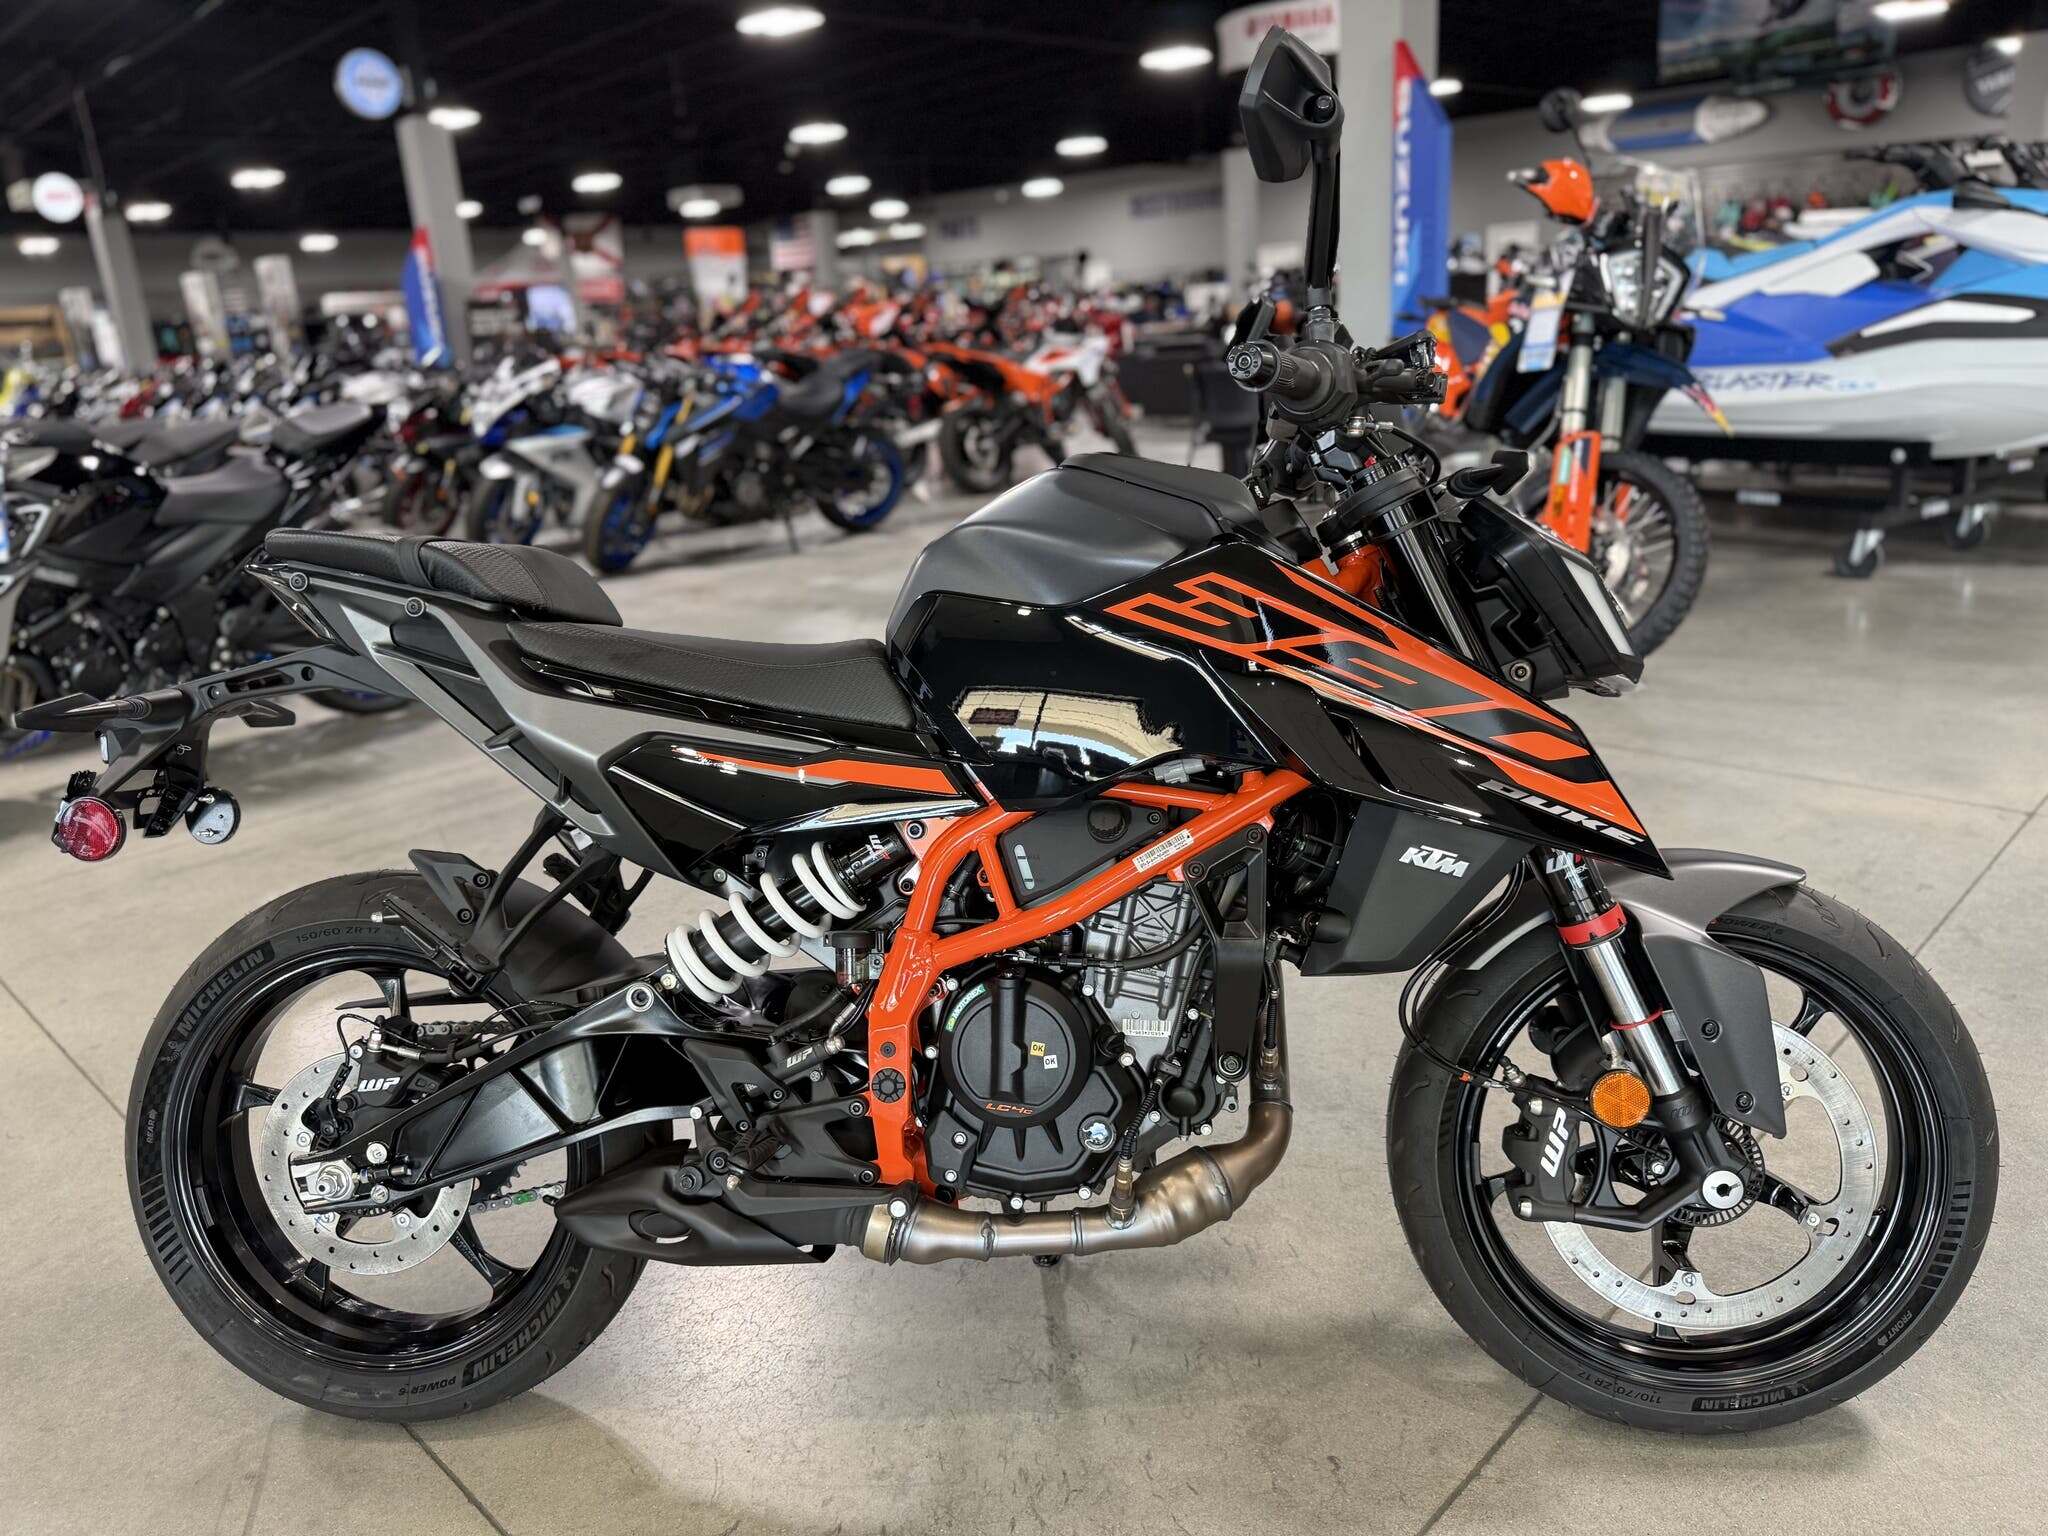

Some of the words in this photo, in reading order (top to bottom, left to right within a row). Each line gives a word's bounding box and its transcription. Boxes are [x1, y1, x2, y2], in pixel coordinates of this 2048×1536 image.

[1395, 78, 1412, 286] SUZUKI
[1477, 779, 1645, 846] DUKE
[1398, 844, 1471, 878] KTM
[295, 927, 342, 944] 150/60
[346, 926, 362, 935] ZR
[177, 950, 265, 1038] MICHELIN
[952, 986, 982, 1019] MOTOREX
[1032, 1044, 1044, 1052] OK
[1045, 1057, 1056, 1066] OK
[146, 1116, 156, 1144] REAR
[472, 1290, 562, 1379] MICHELIN
[1885, 1309, 1913, 1341] FRONT
[410, 1376, 456, 1395] POWER
[1595, 1377, 1615, 1391] ZR
[1616, 1385, 1663, 1404] 110/70
[1700, 1388, 1788, 1411] MICHELIN
